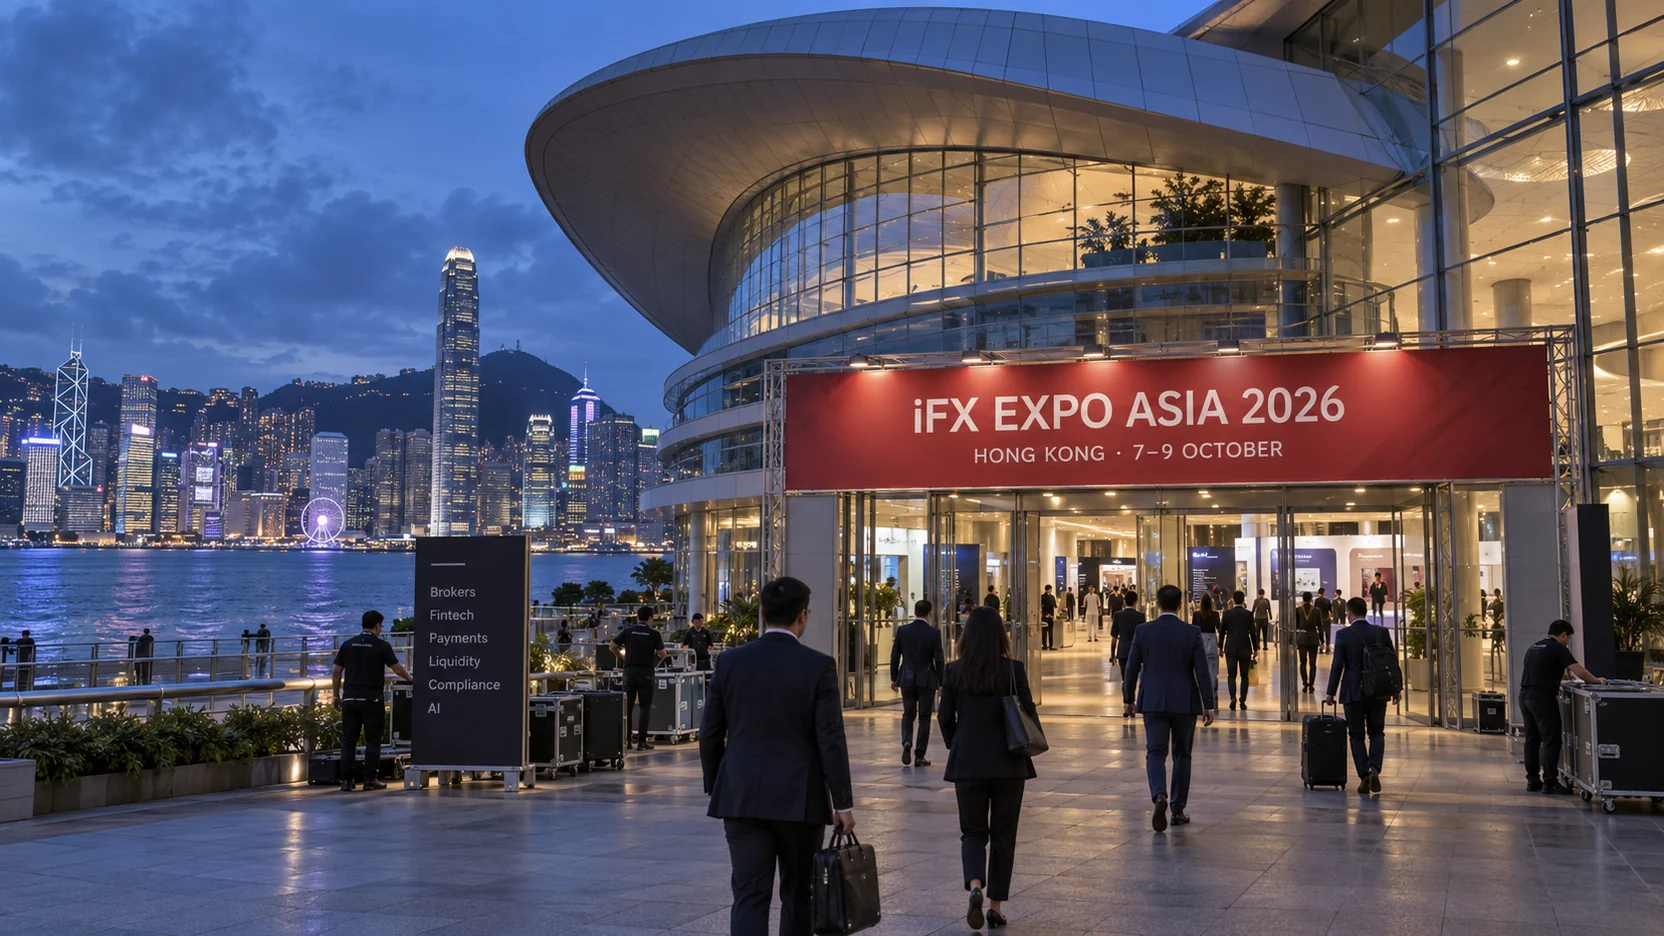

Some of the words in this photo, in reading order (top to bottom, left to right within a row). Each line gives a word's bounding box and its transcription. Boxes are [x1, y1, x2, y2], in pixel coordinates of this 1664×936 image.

[913, 397, 980, 434] iFX
[994, 392, 1113, 432] EXPO
[1126, 389, 1230, 428] ASIA
[1241, 385, 1346, 425] 2026
[974, 446, 1036, 464] HONG
[1045, 445, 1105, 463] KONG
[1182, 440, 1283, 459] OCTOBER
[430, 586, 476, 598] Brokers
[430, 609, 474, 621] Fintech
[429, 632, 488, 647] Payments
[429, 655, 481, 670] Liquidity
[428, 678, 501, 693] Compliance
[427, 702, 441, 714] AI
